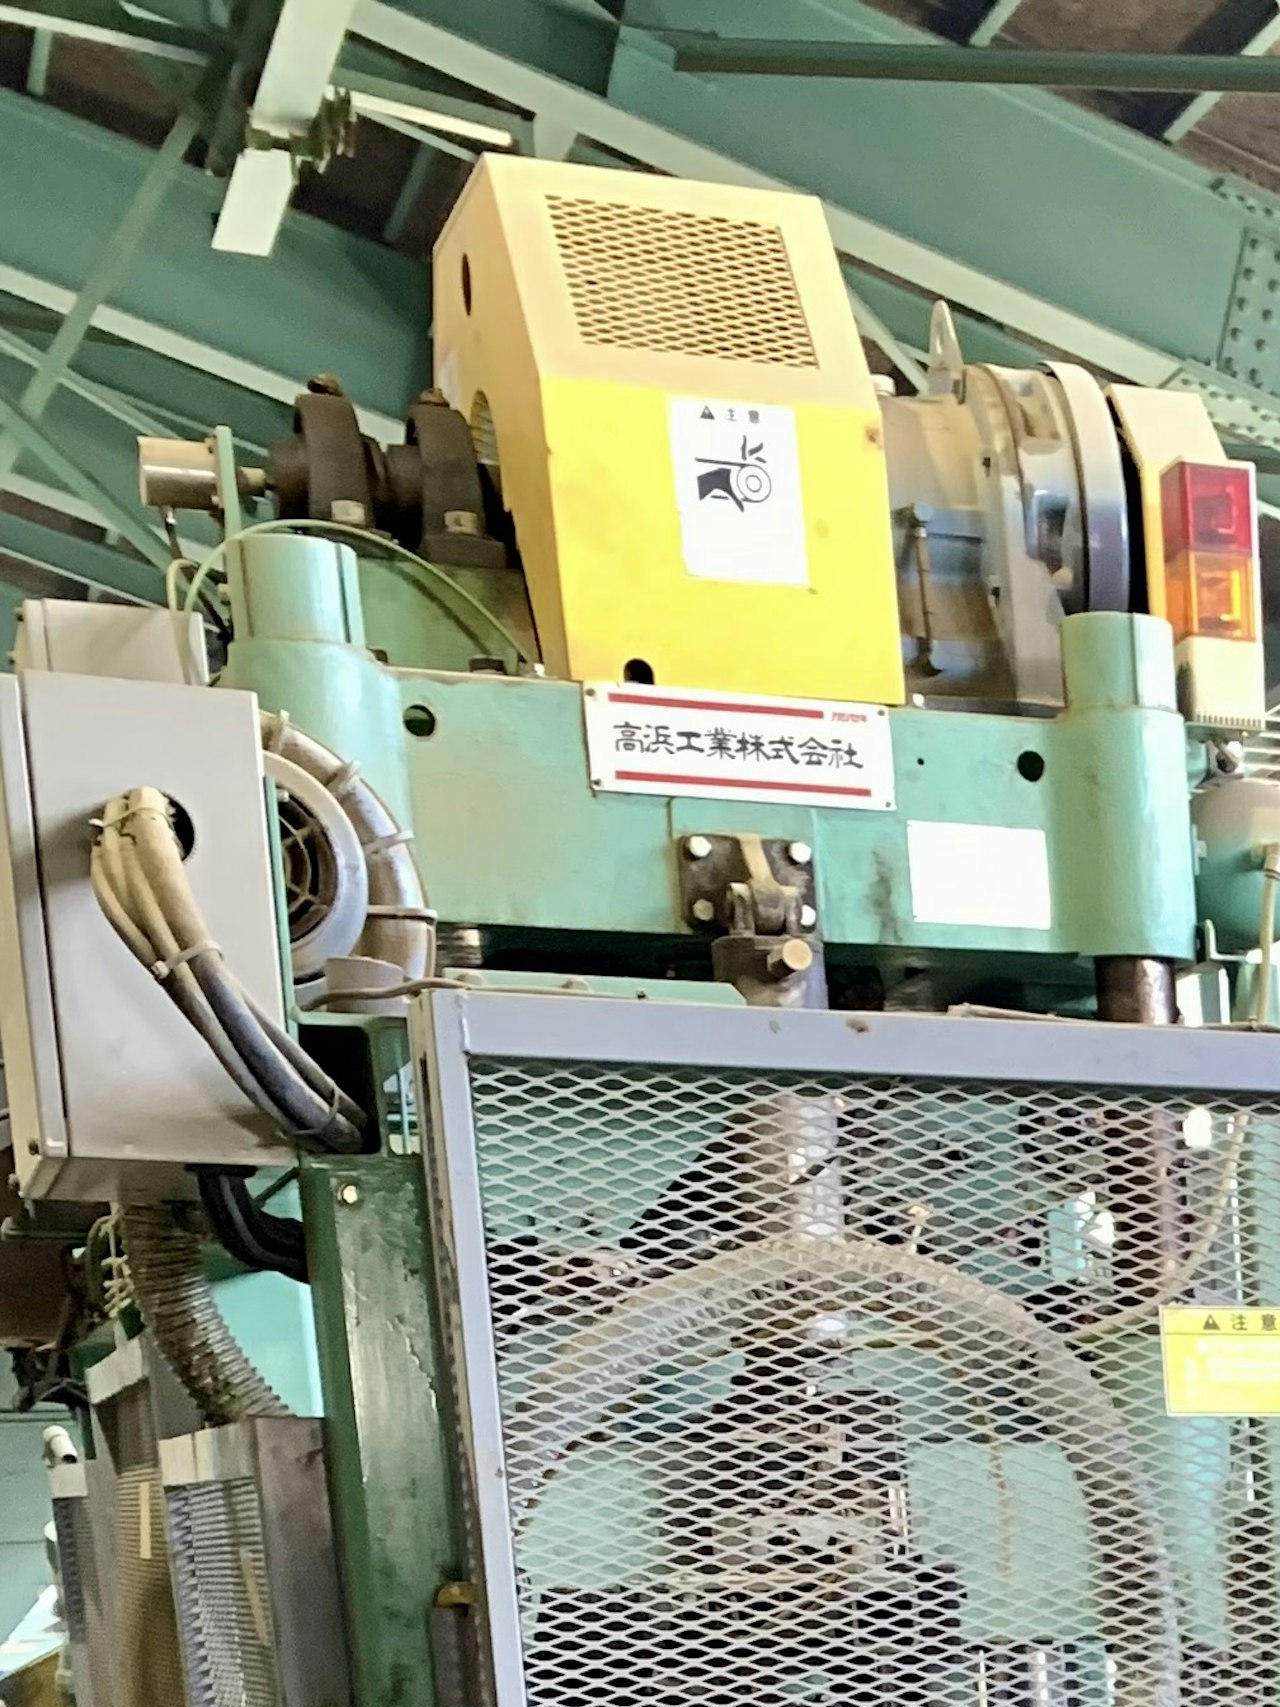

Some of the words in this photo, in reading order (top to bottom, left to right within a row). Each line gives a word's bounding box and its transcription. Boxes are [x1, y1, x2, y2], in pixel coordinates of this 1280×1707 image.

[613, 721, 864, 769] 高浜工業株式会社
[1230, 1313, 1277, 1332] 注意
